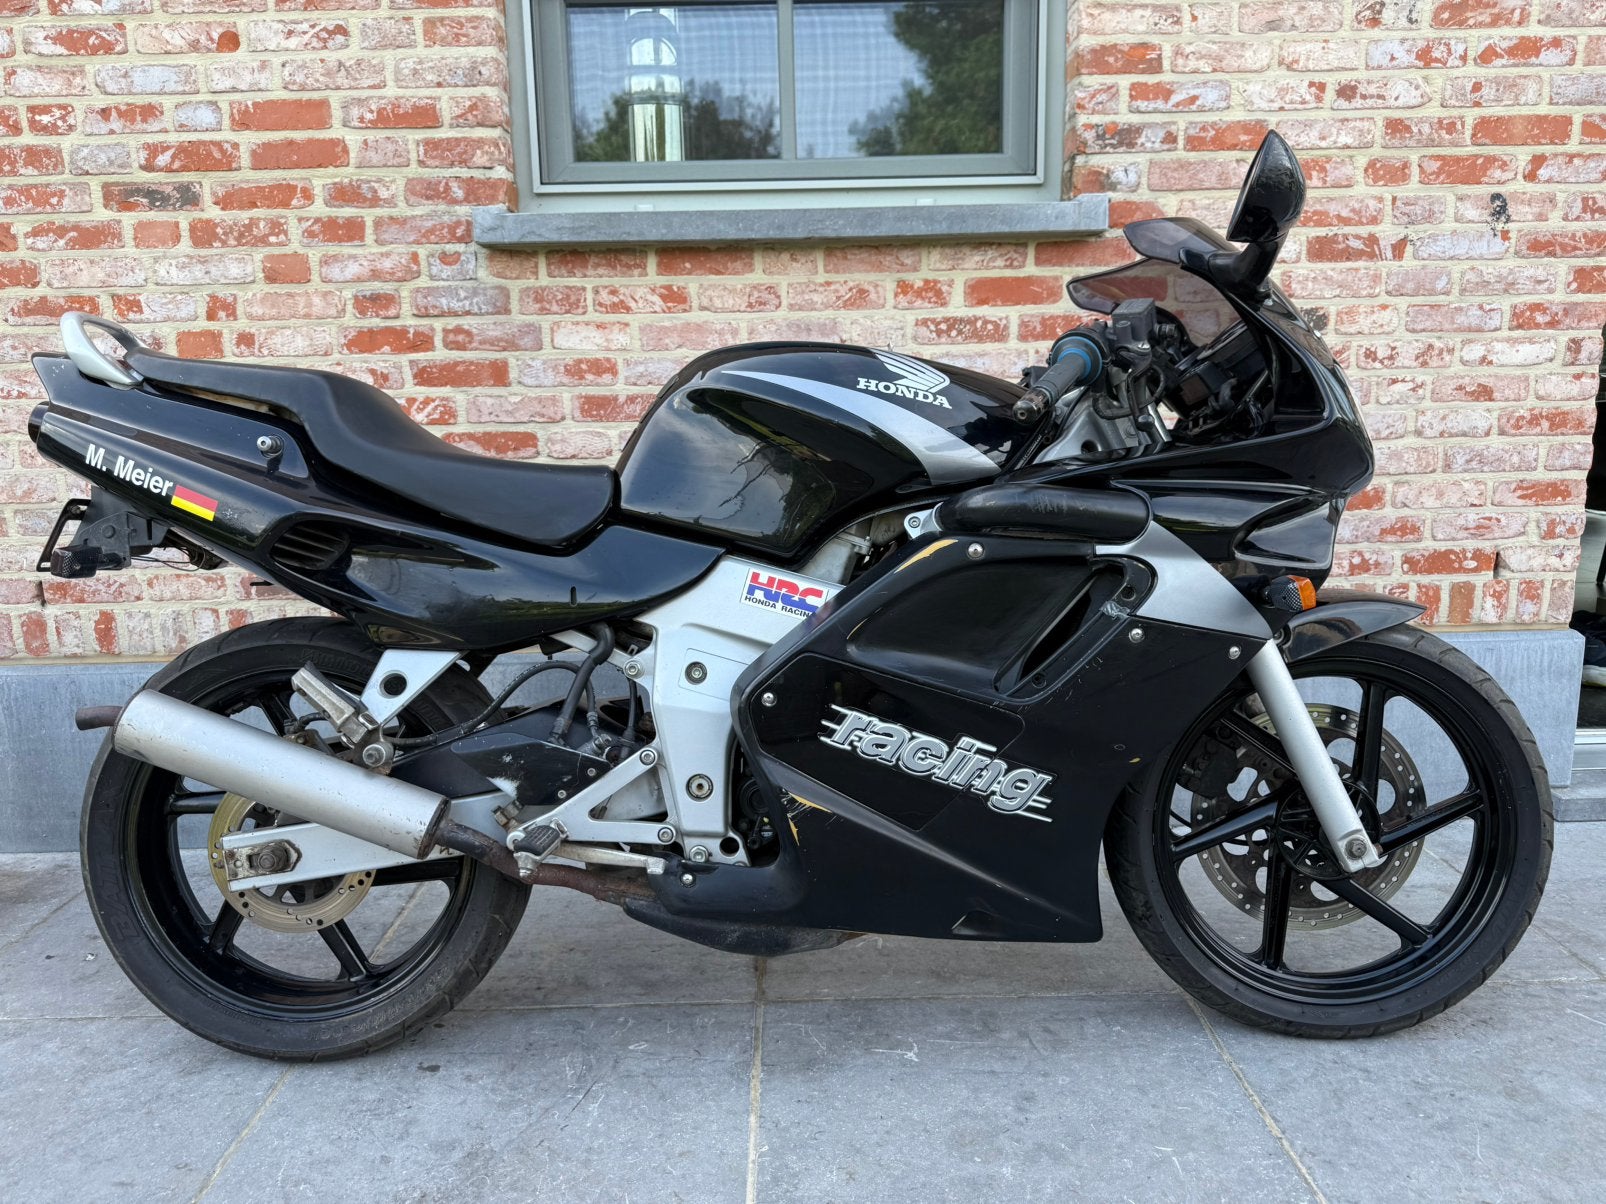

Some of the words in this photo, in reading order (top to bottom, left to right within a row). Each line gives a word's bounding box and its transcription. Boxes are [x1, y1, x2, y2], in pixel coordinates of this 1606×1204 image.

[856, 377, 952, 409] HONDA
[85, 443, 107, 472] M.
[113, 455, 174, 496] Meier
[744, 595, 777, 610] HONDA
[780, 605, 813, 619] RACIN
[746, 571, 824, 613] HRC
[825, 706, 1053, 815] racing
